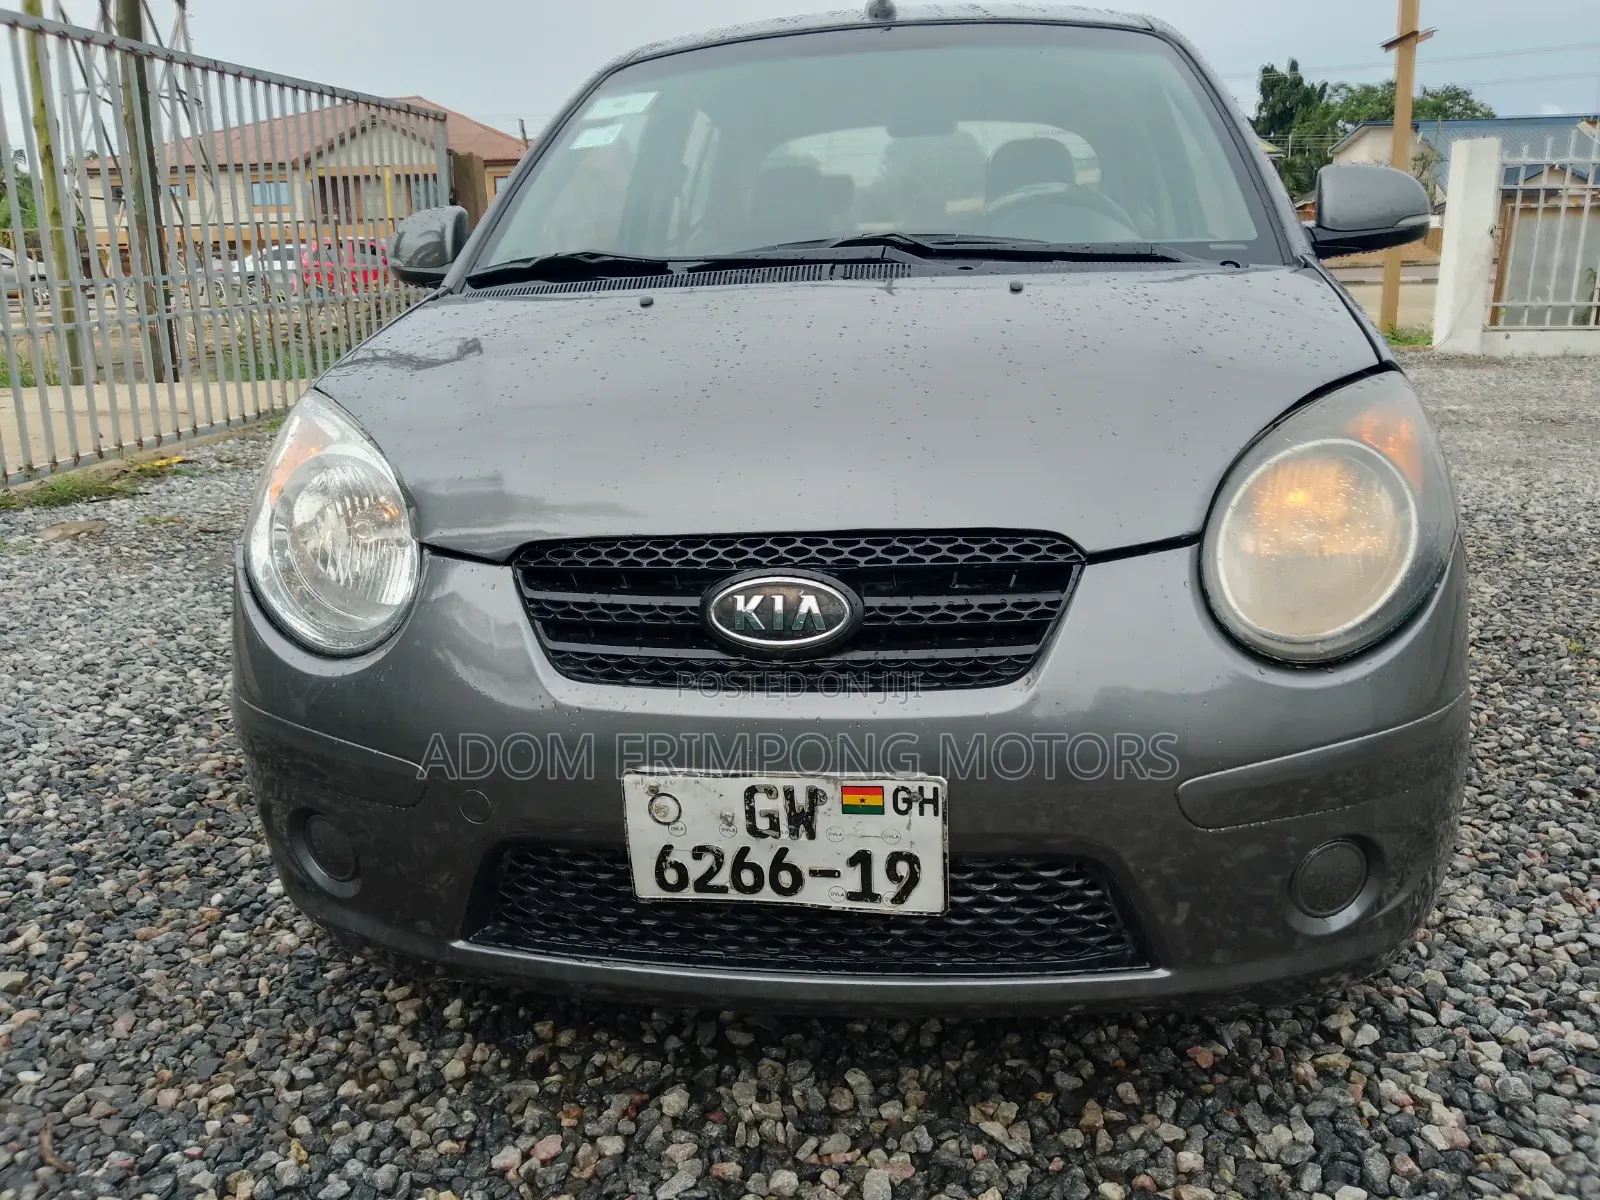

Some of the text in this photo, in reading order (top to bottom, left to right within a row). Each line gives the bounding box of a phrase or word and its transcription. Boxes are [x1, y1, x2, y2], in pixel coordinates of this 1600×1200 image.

[733, 595, 827, 631] KIA
[743, 784, 819, 841] GW
[892, 785, 939, 817] GH
[654, 844, 922, 905] 6266-19
